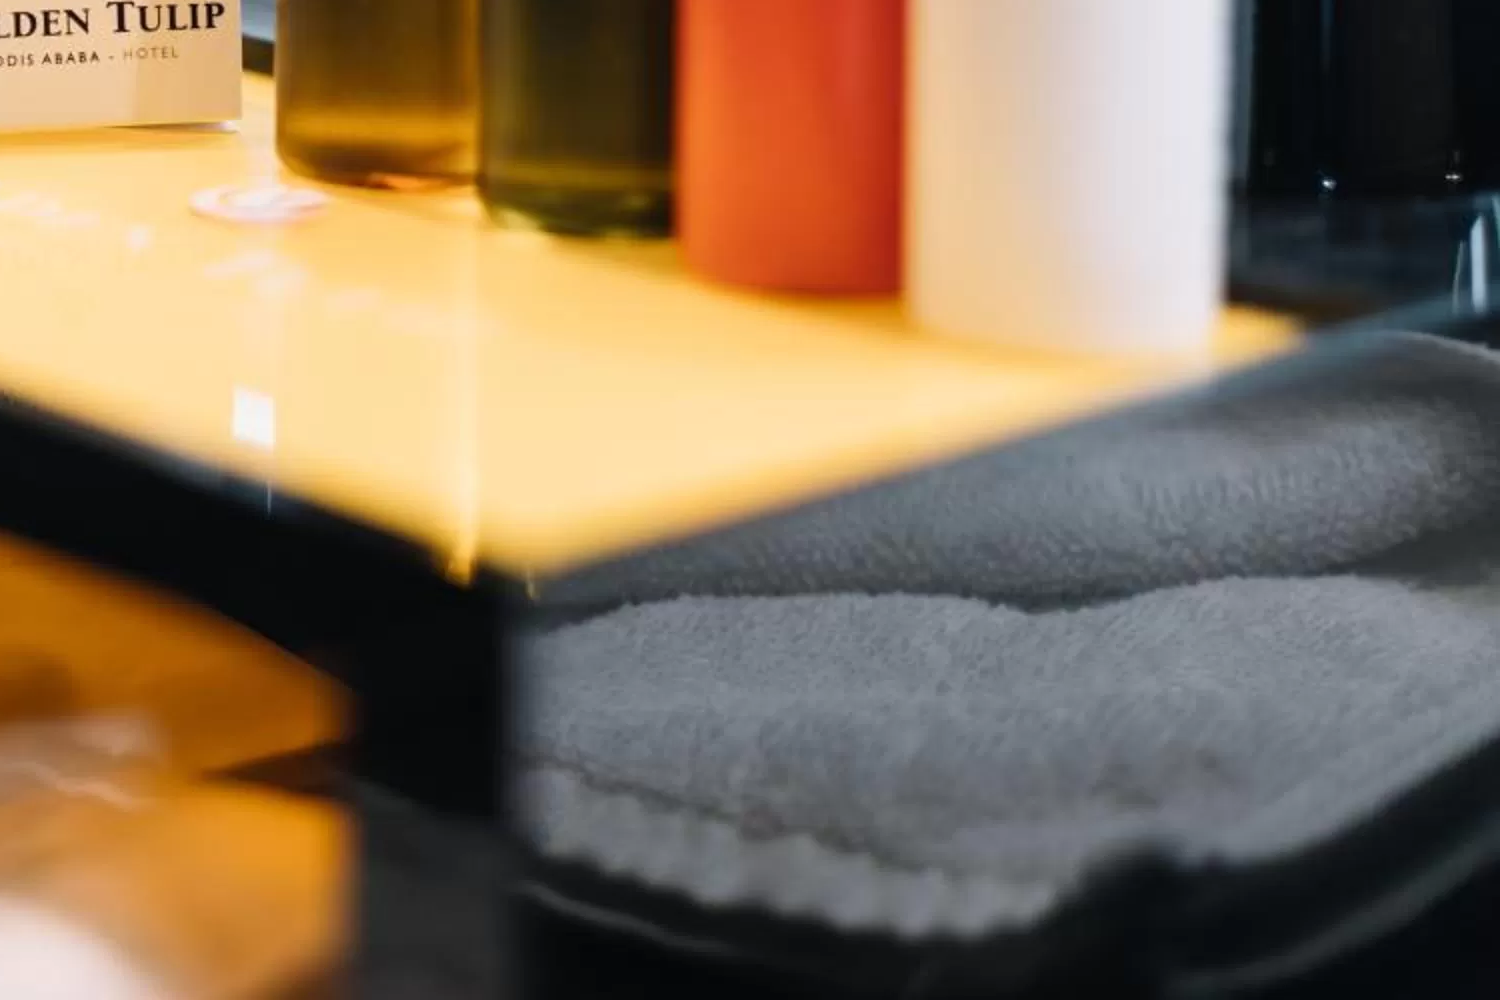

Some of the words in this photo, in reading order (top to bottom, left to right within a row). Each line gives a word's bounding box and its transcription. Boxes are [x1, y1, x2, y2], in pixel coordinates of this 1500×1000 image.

[105, 0, 225, 33] TULIP
[41, 51, 100, 65] ABABA
[123, 46, 179, 60] HOTEL
